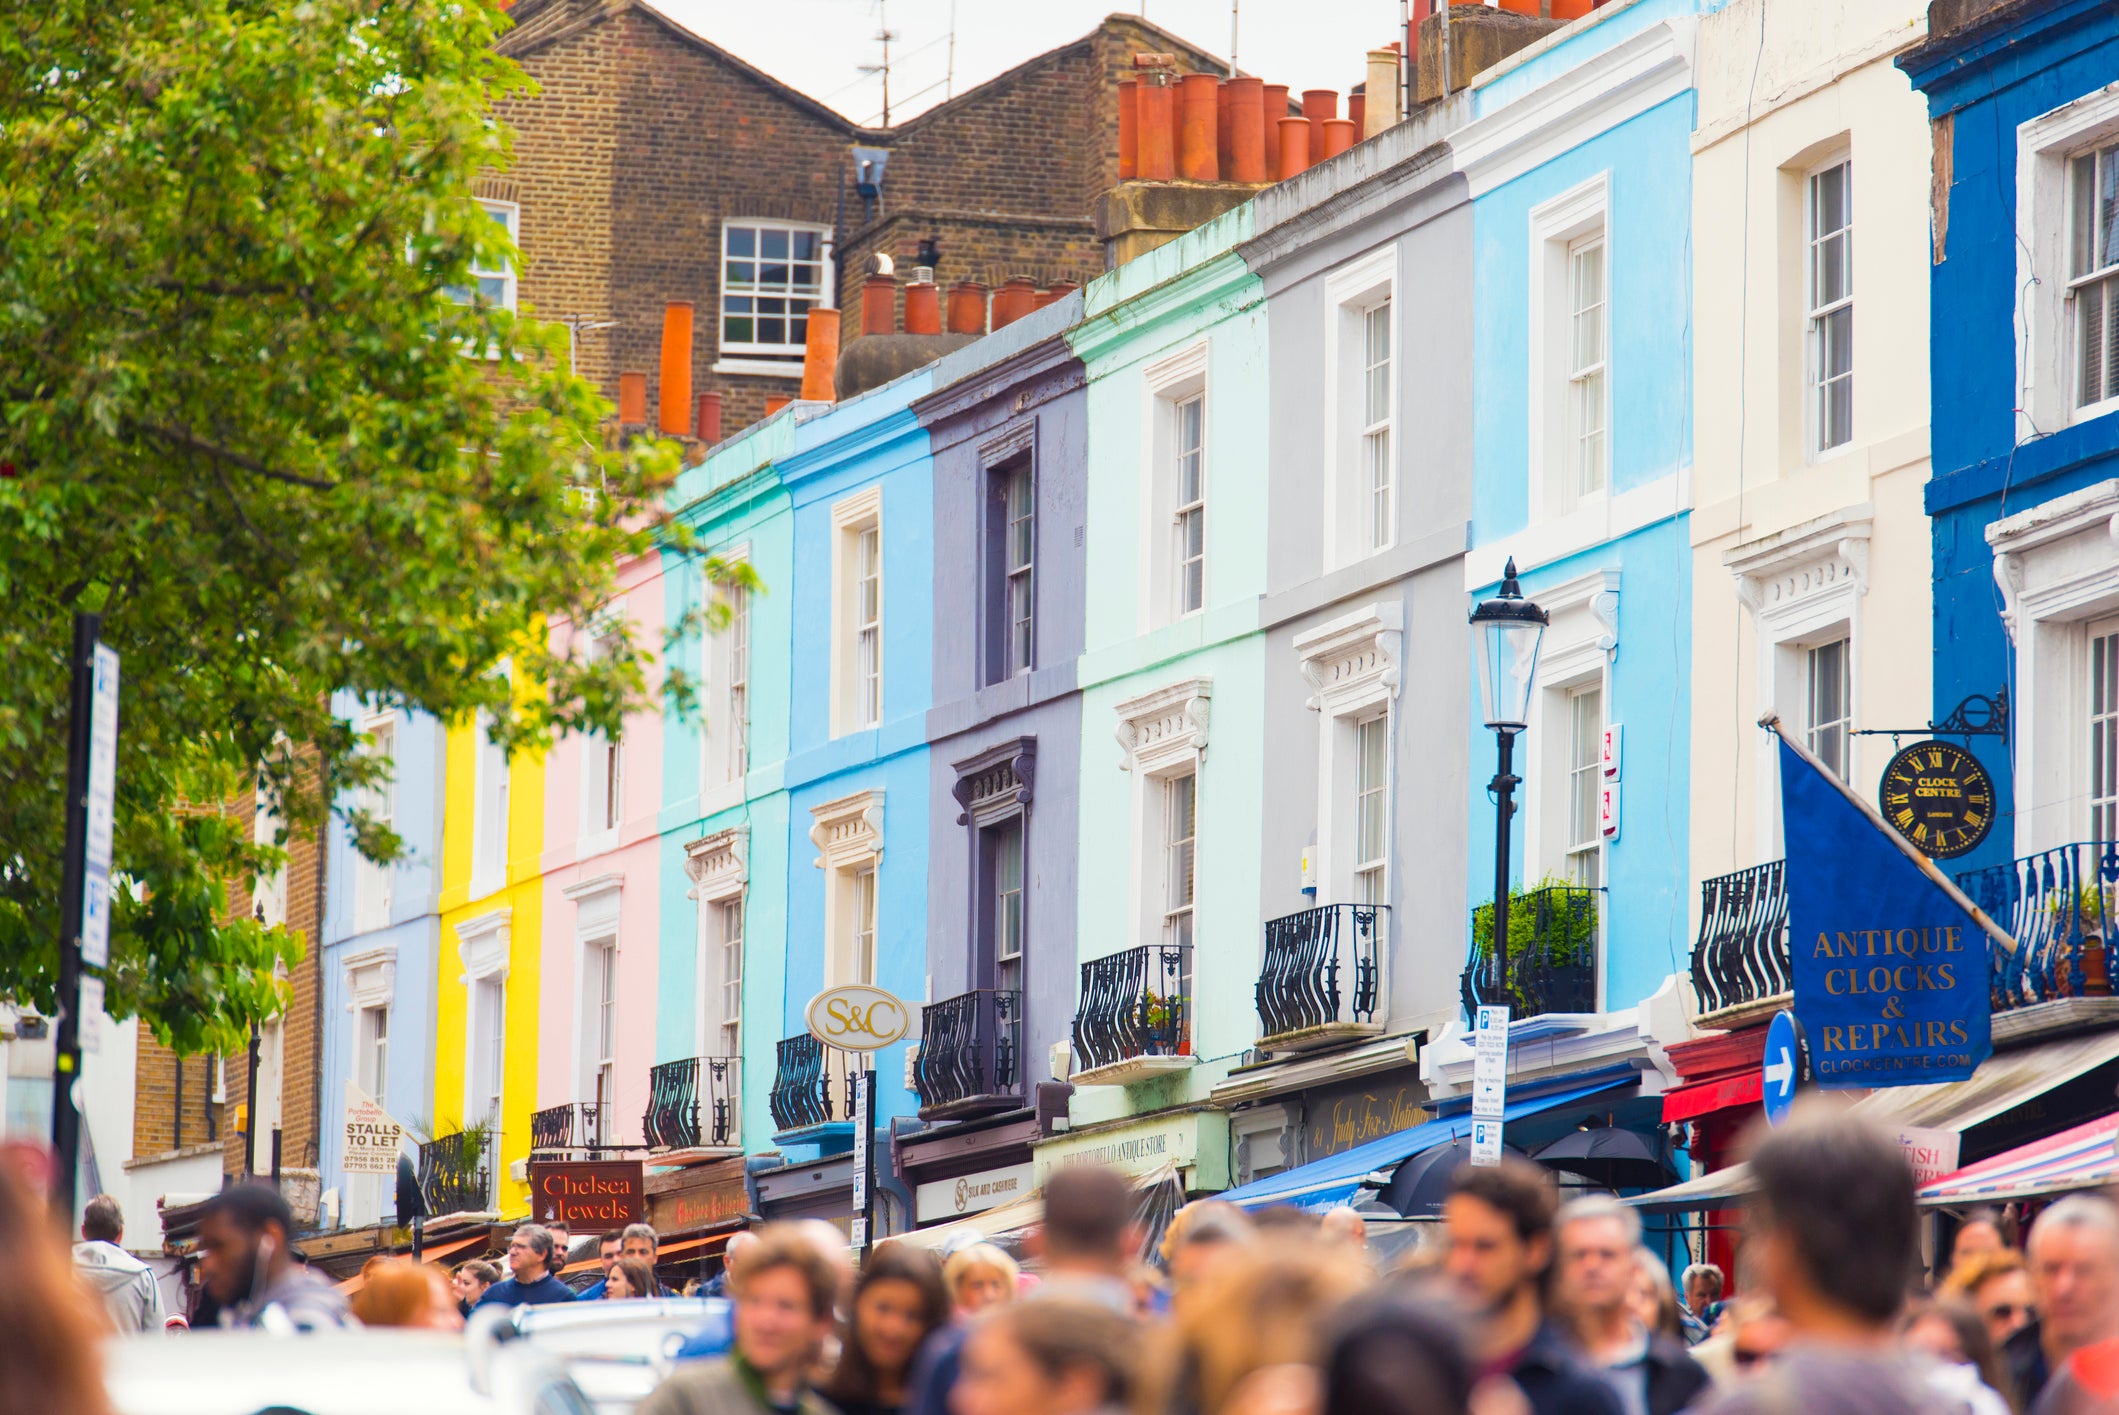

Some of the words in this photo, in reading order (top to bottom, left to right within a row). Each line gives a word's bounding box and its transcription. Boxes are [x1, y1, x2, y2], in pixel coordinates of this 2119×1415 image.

[1914, 787, 1962, 798] CENTRE
[1917, 777, 1958, 787] CLOCK
[1812, 926, 1964, 960] ANTIQUE
[1825, 963, 1956, 995] CLOCKS
[825, 997, 896, 1038] S&C
[1881, 995, 1905, 1019] &
[1822, 1019, 1968, 1052] REPAIRS
[348, 1108, 382, 1116] Portobello
[355, 1115, 377, 1123] Group
[346, 1123, 401, 1136] STALLS
[1326, 1099, 1356, 1155] Judy
[1357, 1094, 1380, 1139] Fox
[347, 1135, 367, 1146] TO
[371, 1136, 399, 1147] LET
[1117, 1138, 1145, 1162] ANTIQUE
[1146, 1133, 1167, 1157] STORE
[1904, 1147, 1939, 1165] TISH
[543, 1173, 631, 1196] Chelsea
[968, 1184, 980, 1199] SILK
[991, 1177, 1018, 1194] CASHMERE
[558, 1198, 630, 1222] Jewels
